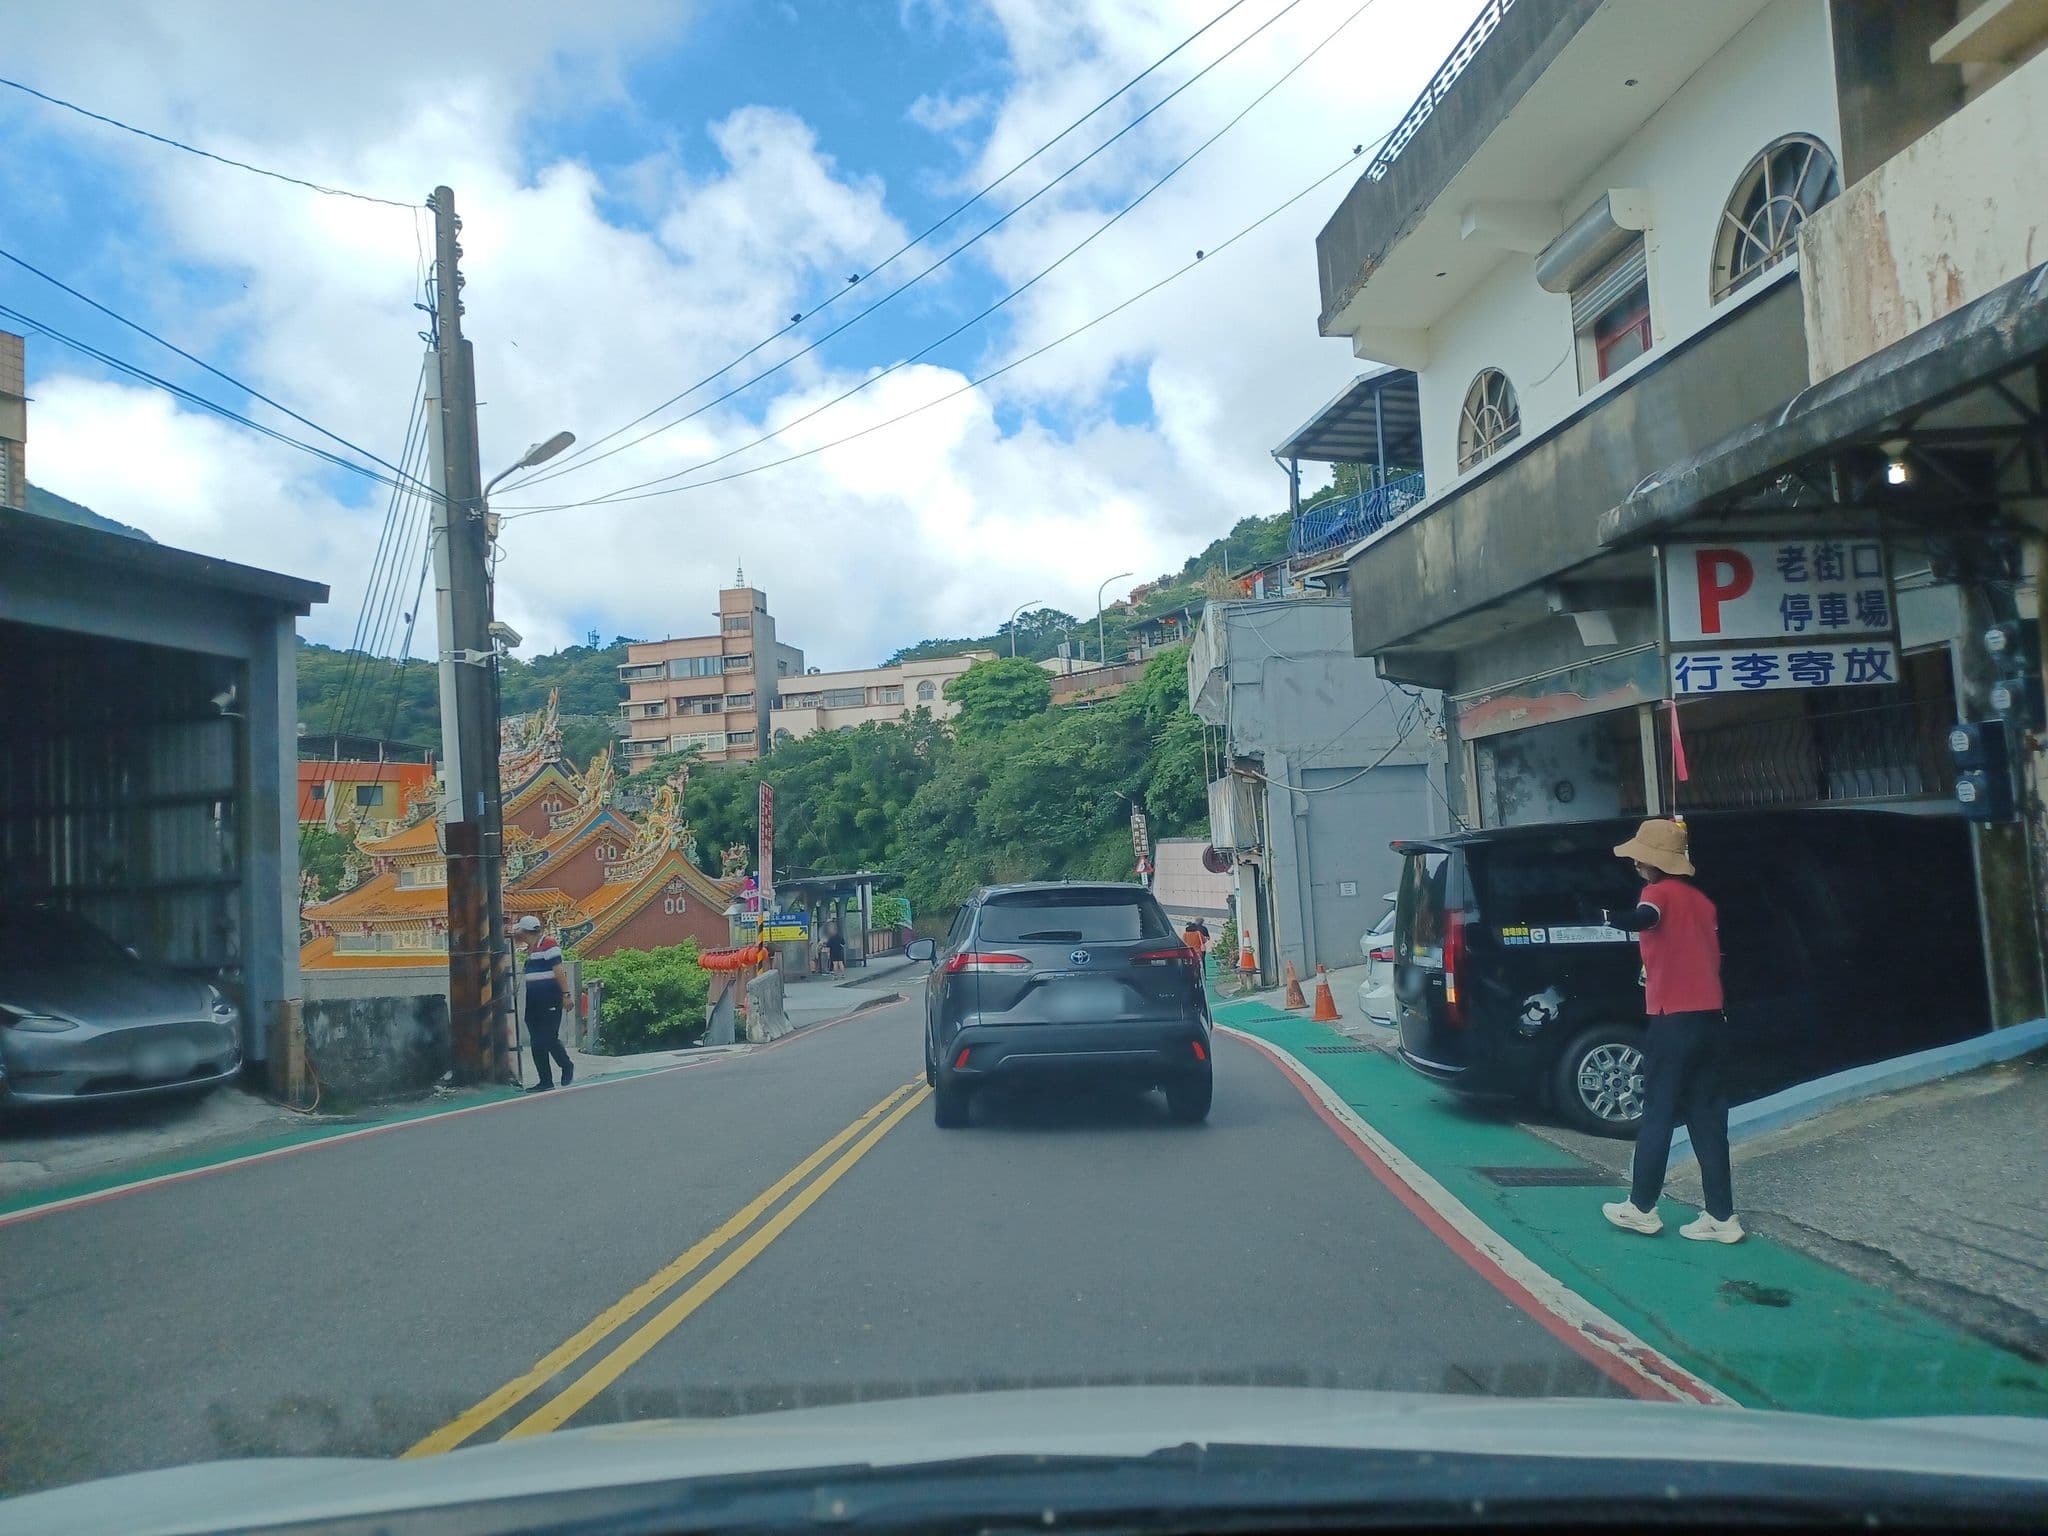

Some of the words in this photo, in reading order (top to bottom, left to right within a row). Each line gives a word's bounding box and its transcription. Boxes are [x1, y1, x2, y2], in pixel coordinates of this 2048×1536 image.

[1776, 543, 1882, 583] 老街口
[1696, 549, 1754, 634] P
[1779, 590, 1890, 632] 停車場
[1675, 646, 1894, 692] 行李寄放
